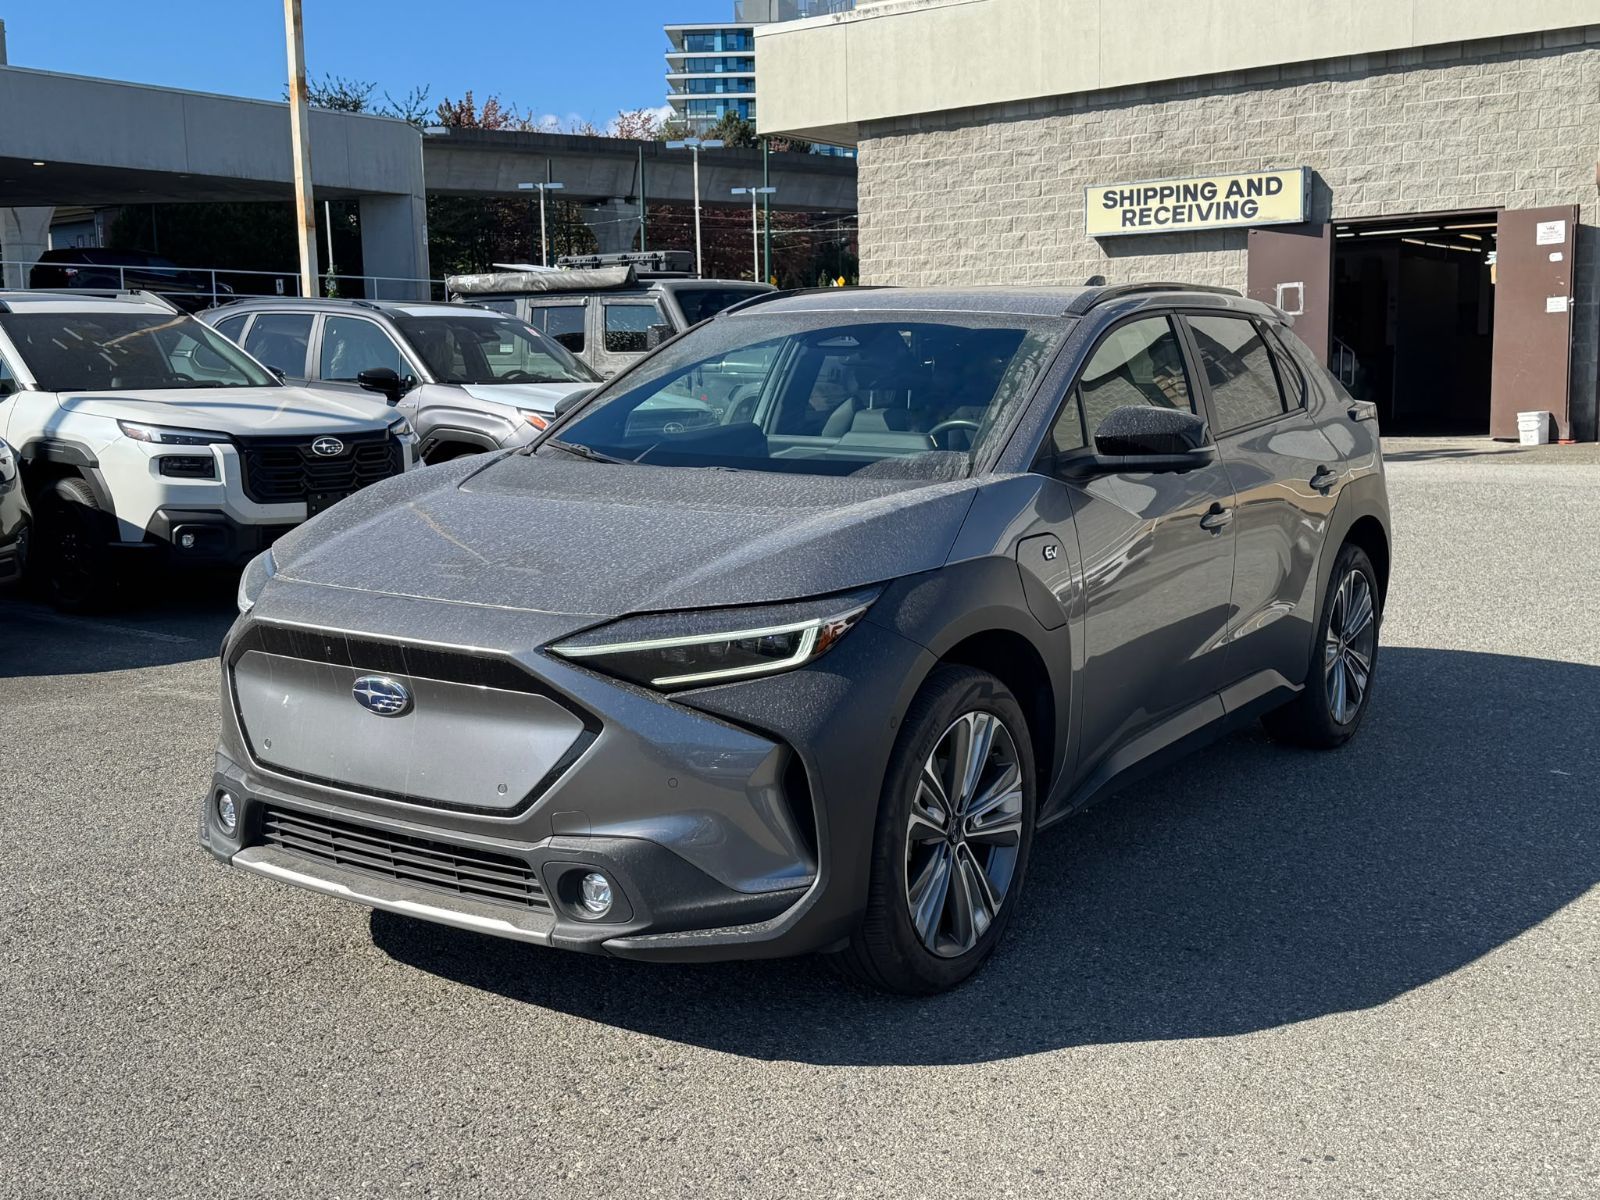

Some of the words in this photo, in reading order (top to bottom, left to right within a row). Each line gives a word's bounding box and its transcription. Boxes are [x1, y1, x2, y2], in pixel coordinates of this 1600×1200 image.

[1102, 181, 1218, 210] SHIPPING
[1224, 176, 1283, 200] AND
[1121, 199, 1259, 227] RECEIVING
[1044, 546, 1058, 559] EV
